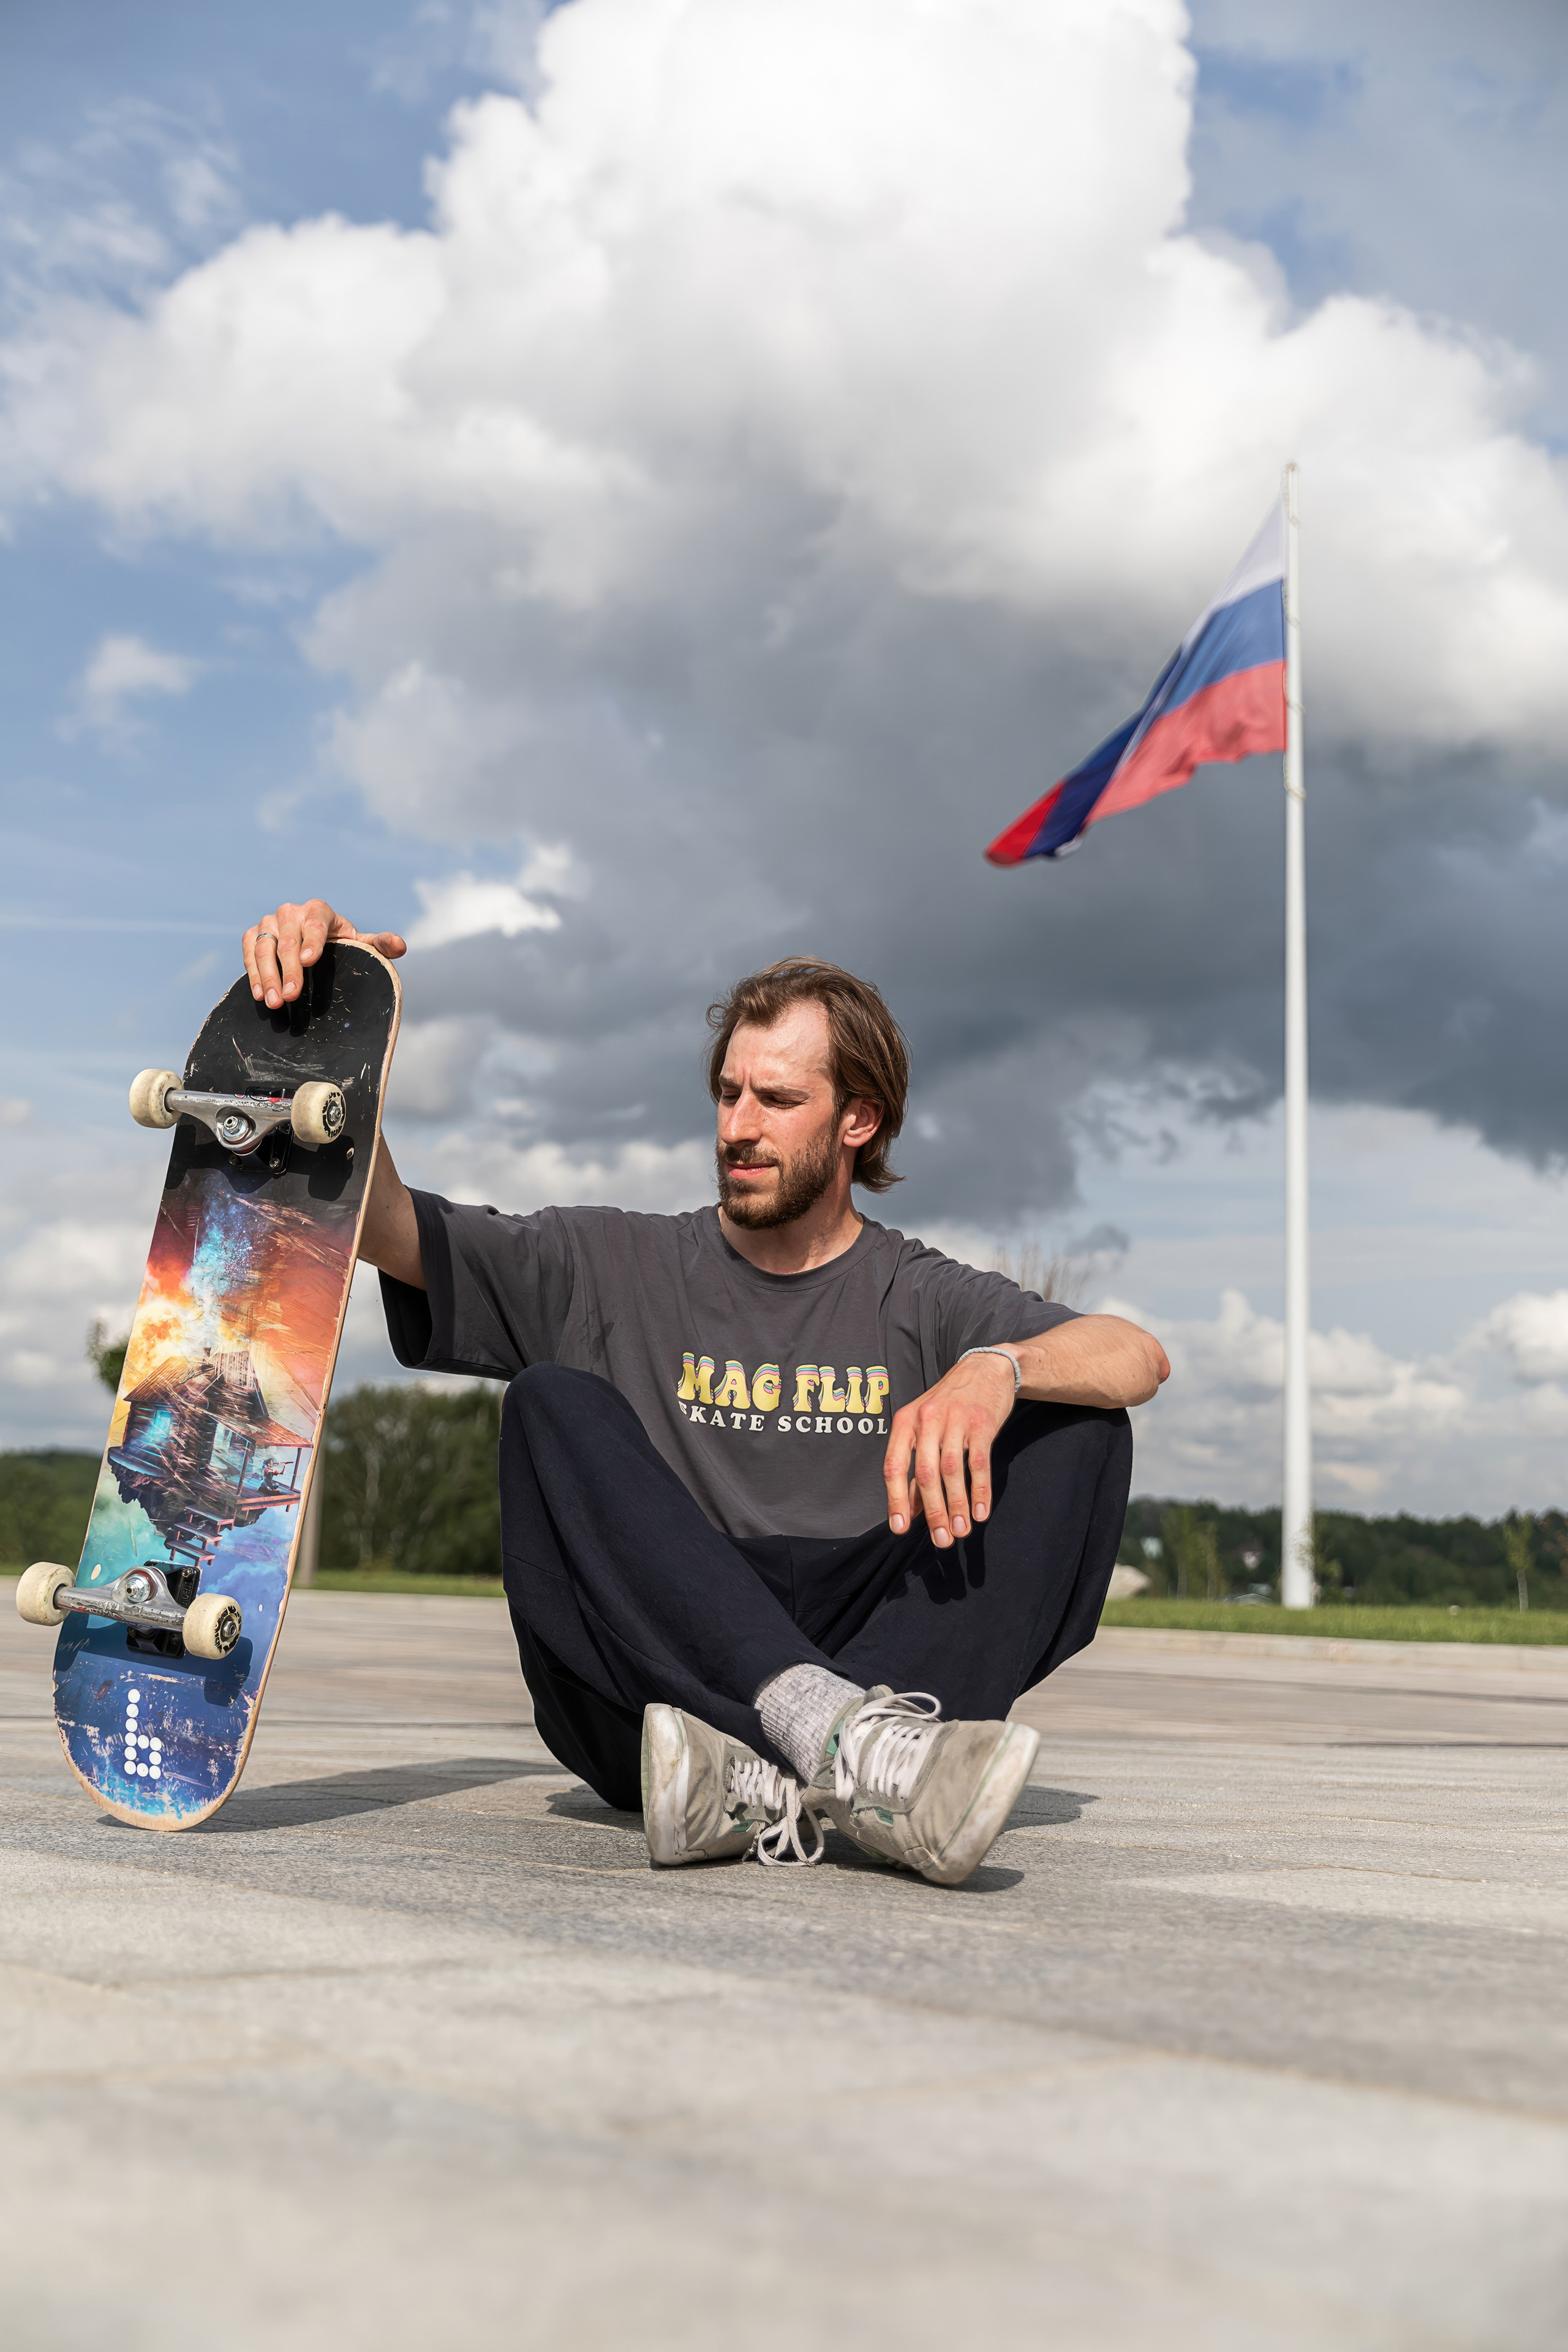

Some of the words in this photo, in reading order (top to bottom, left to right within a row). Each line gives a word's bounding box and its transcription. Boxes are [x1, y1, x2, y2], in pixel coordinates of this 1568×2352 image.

[677, 1352, 782, 1411] MAG
[793, 1364, 890, 1414] FLIP
[777, 1415, 888, 1434] SCHOOL
